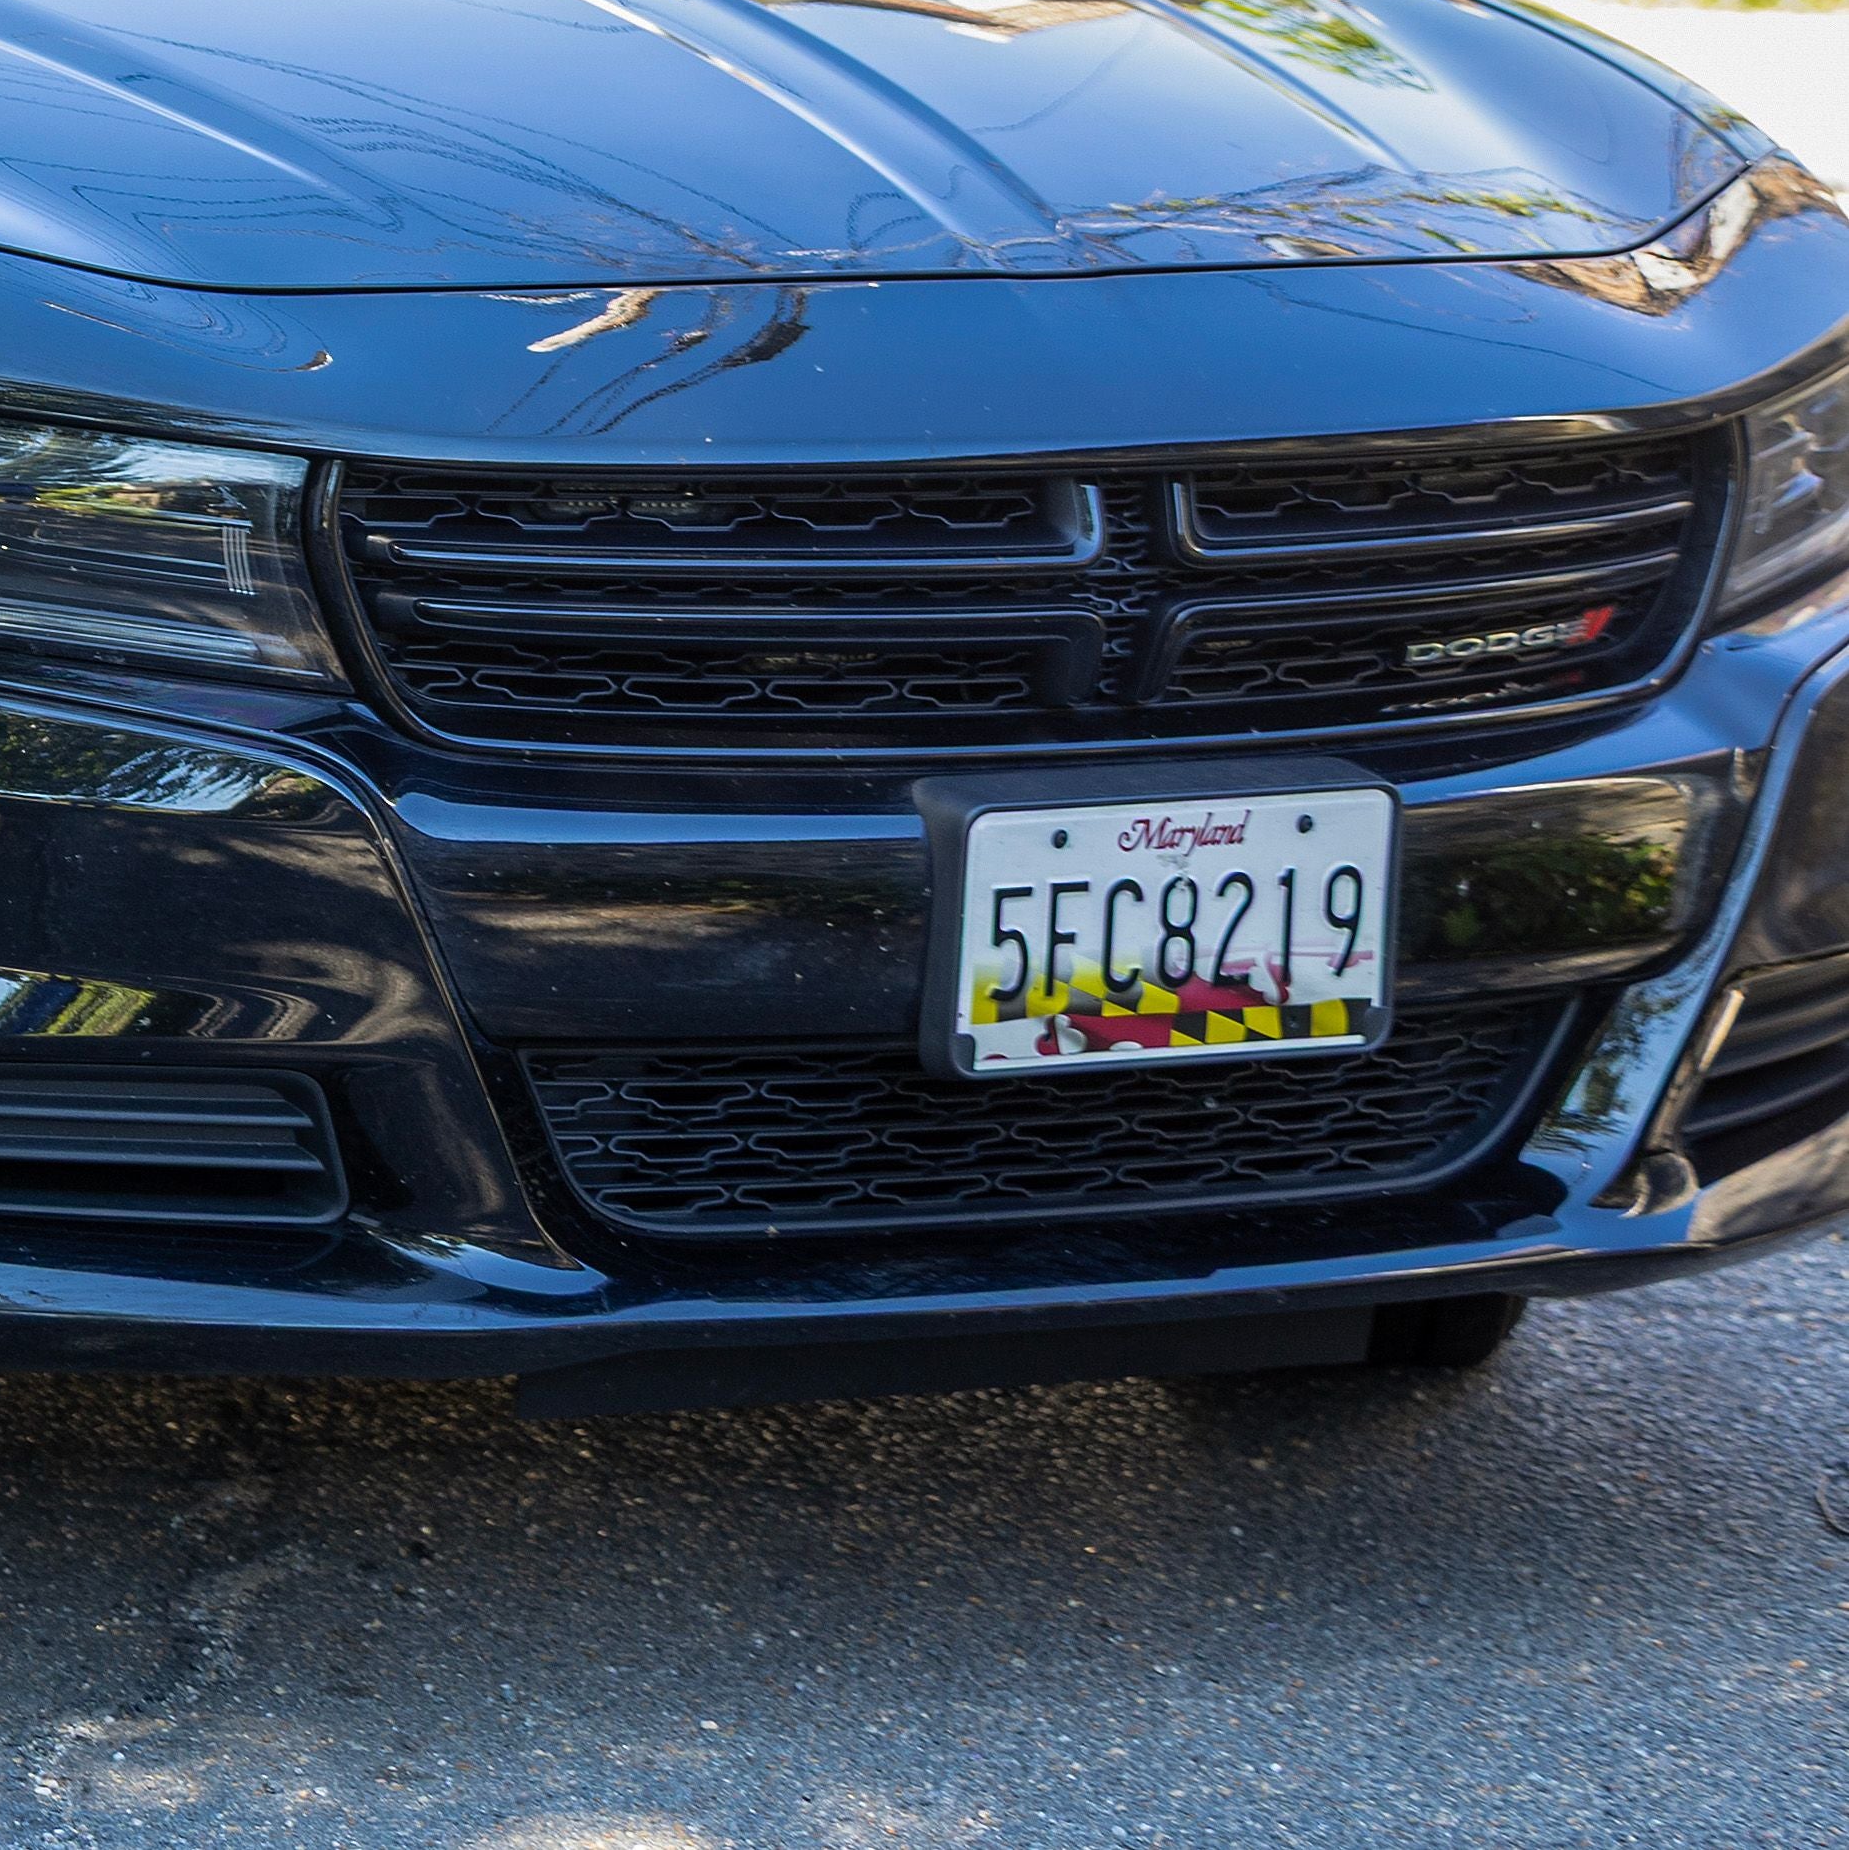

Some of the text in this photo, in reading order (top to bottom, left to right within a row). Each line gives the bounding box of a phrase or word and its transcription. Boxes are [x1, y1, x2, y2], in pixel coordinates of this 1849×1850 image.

[1405, 619, 1589, 665] DODGE
[1117, 809, 1254, 857] Maryland
[988, 863, 1364, 1002] 5FC8219
